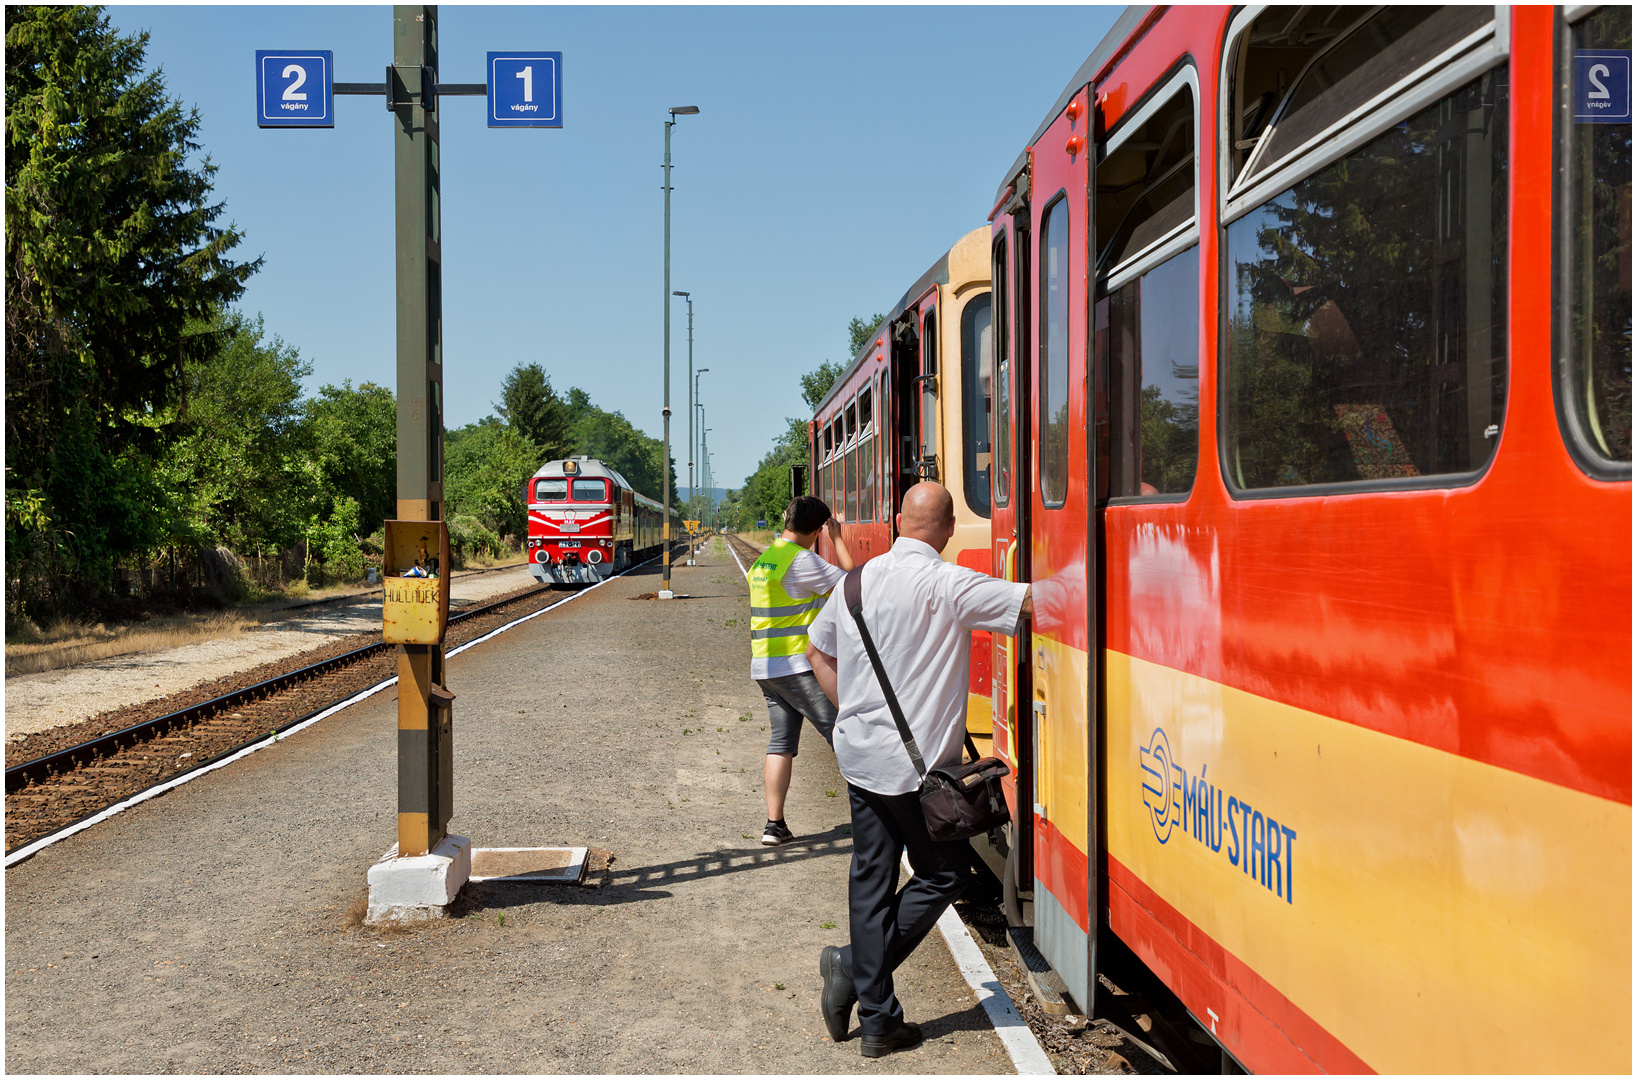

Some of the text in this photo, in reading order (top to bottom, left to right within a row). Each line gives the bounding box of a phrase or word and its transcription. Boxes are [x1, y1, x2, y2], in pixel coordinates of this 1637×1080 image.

[282, 64, 307, 100] 2
[516, 66, 532, 102] 1
[280, 102, 309, 111] vágány
[510, 103, 539, 112] vágány
[689, 521, 694, 531] 6
